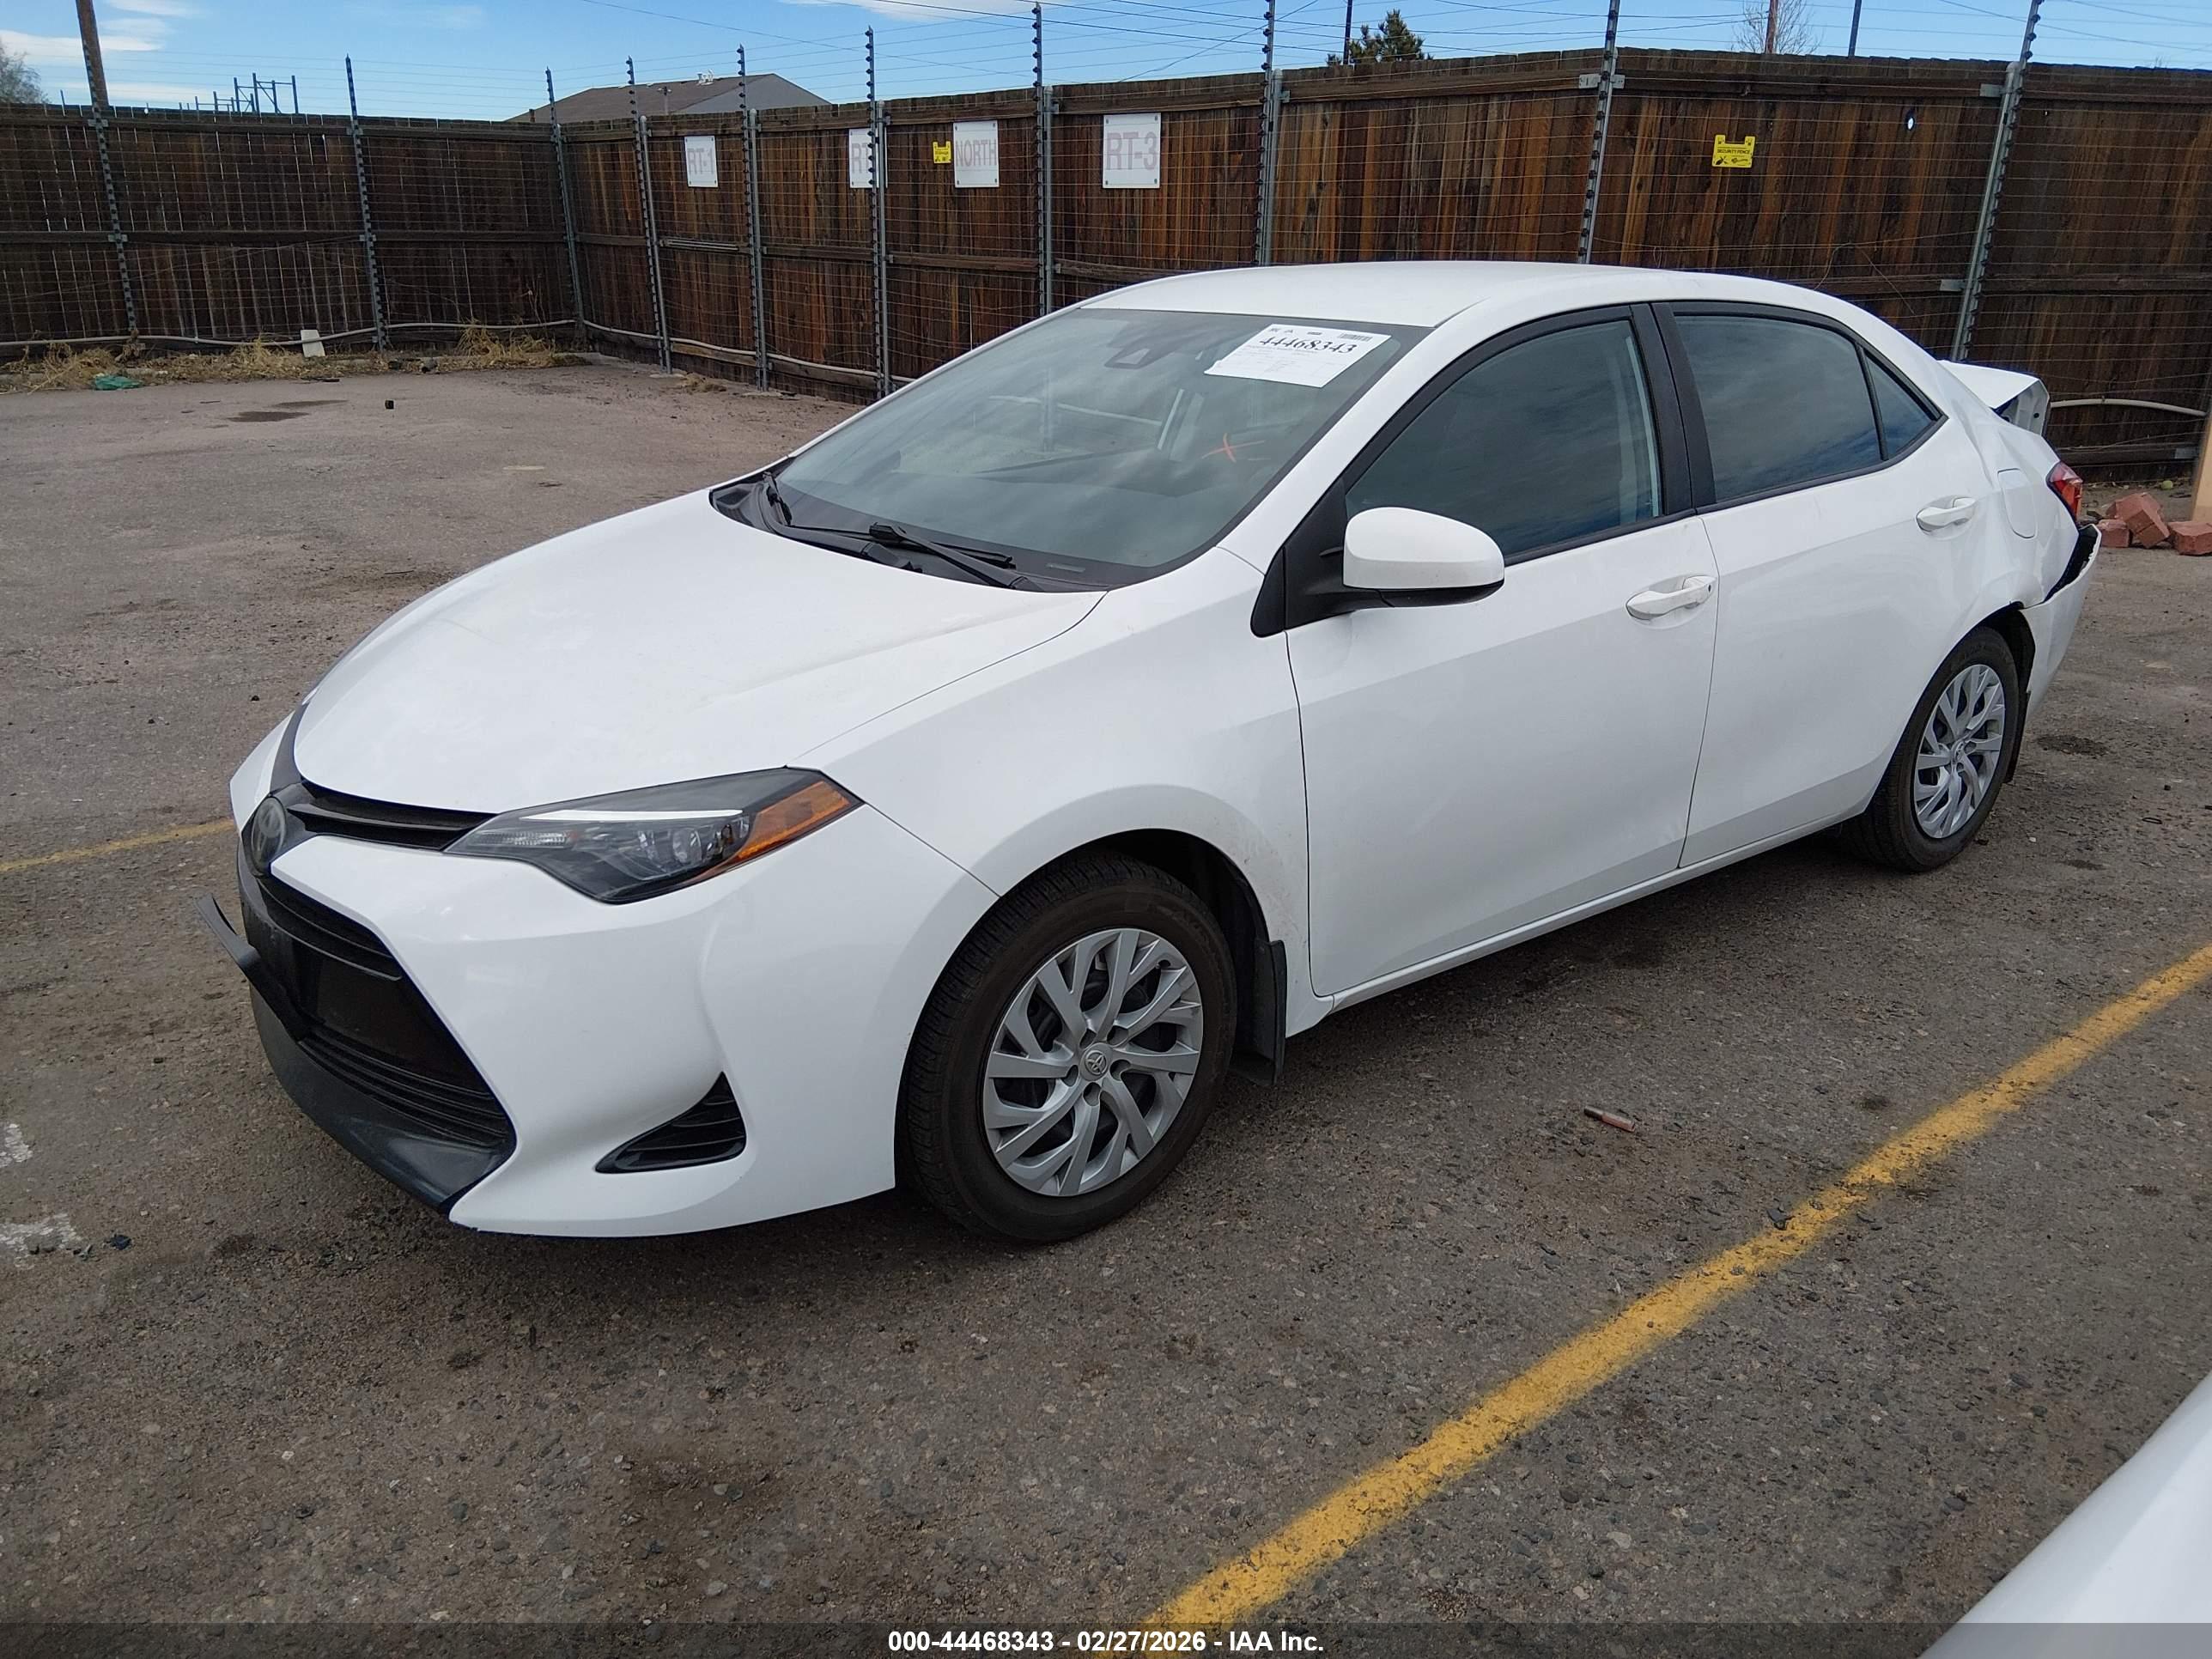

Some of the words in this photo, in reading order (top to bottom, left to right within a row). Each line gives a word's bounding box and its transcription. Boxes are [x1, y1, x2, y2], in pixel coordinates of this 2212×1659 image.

[687, 148, 714, 175] RT-1
[956, 139, 997, 167] NORTH
[1106, 131, 1158, 170] RT-3
[1260, 336, 1358, 354] 44468343
